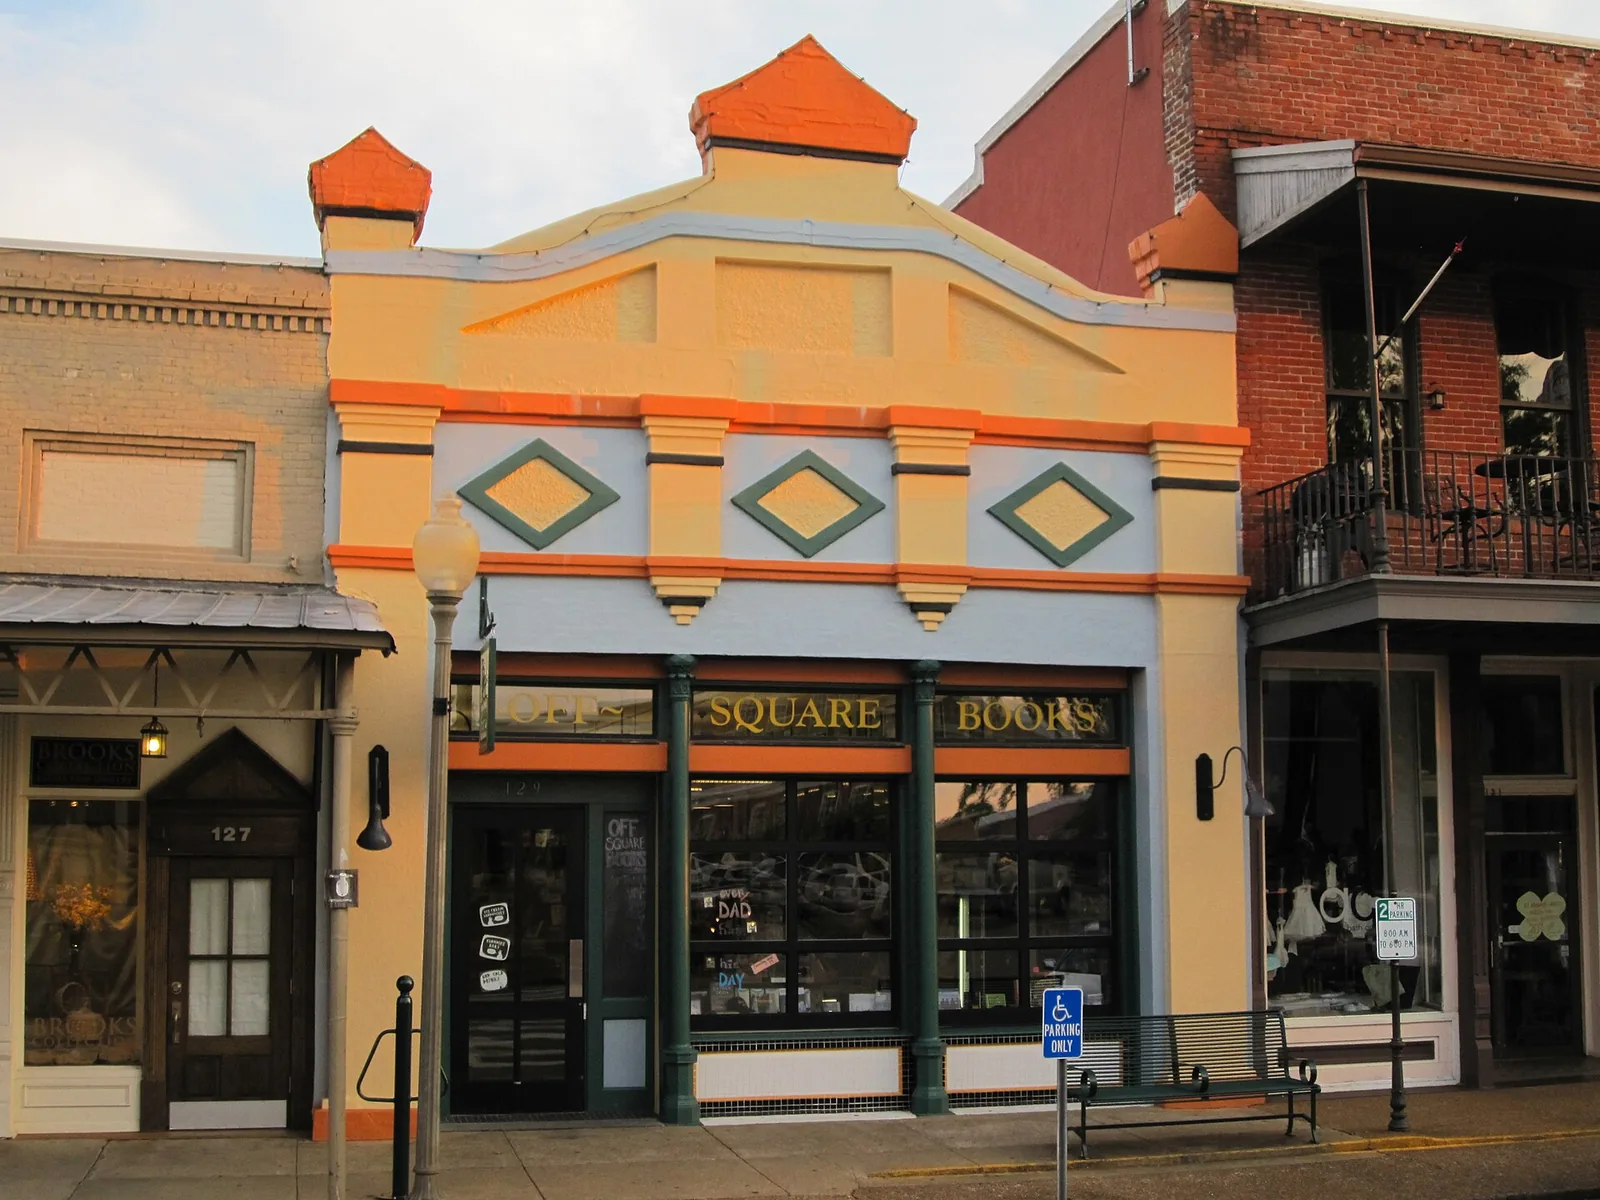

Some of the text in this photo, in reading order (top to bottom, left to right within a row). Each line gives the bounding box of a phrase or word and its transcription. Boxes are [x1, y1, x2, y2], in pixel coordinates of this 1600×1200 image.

[508, 692, 1097, 734] OFF SQUARE BOOKS
[39, 743, 136, 762] BROOKS
[506, 780, 541, 796] 129
[211, 826, 252, 842] 127
[608, 818, 640, 838] OFF
[604, 837, 645, 851] SQUARE
[719, 888, 751, 901] every
[718, 901, 752, 919] DAD
[1379, 902, 1388, 918] 2
[1389, 911, 1413, 919] PARKING
[719, 971, 745, 992] DAY
[1044, 1022, 1081, 1037] PARKING
[1051, 1039, 1073, 1053] ONLY
